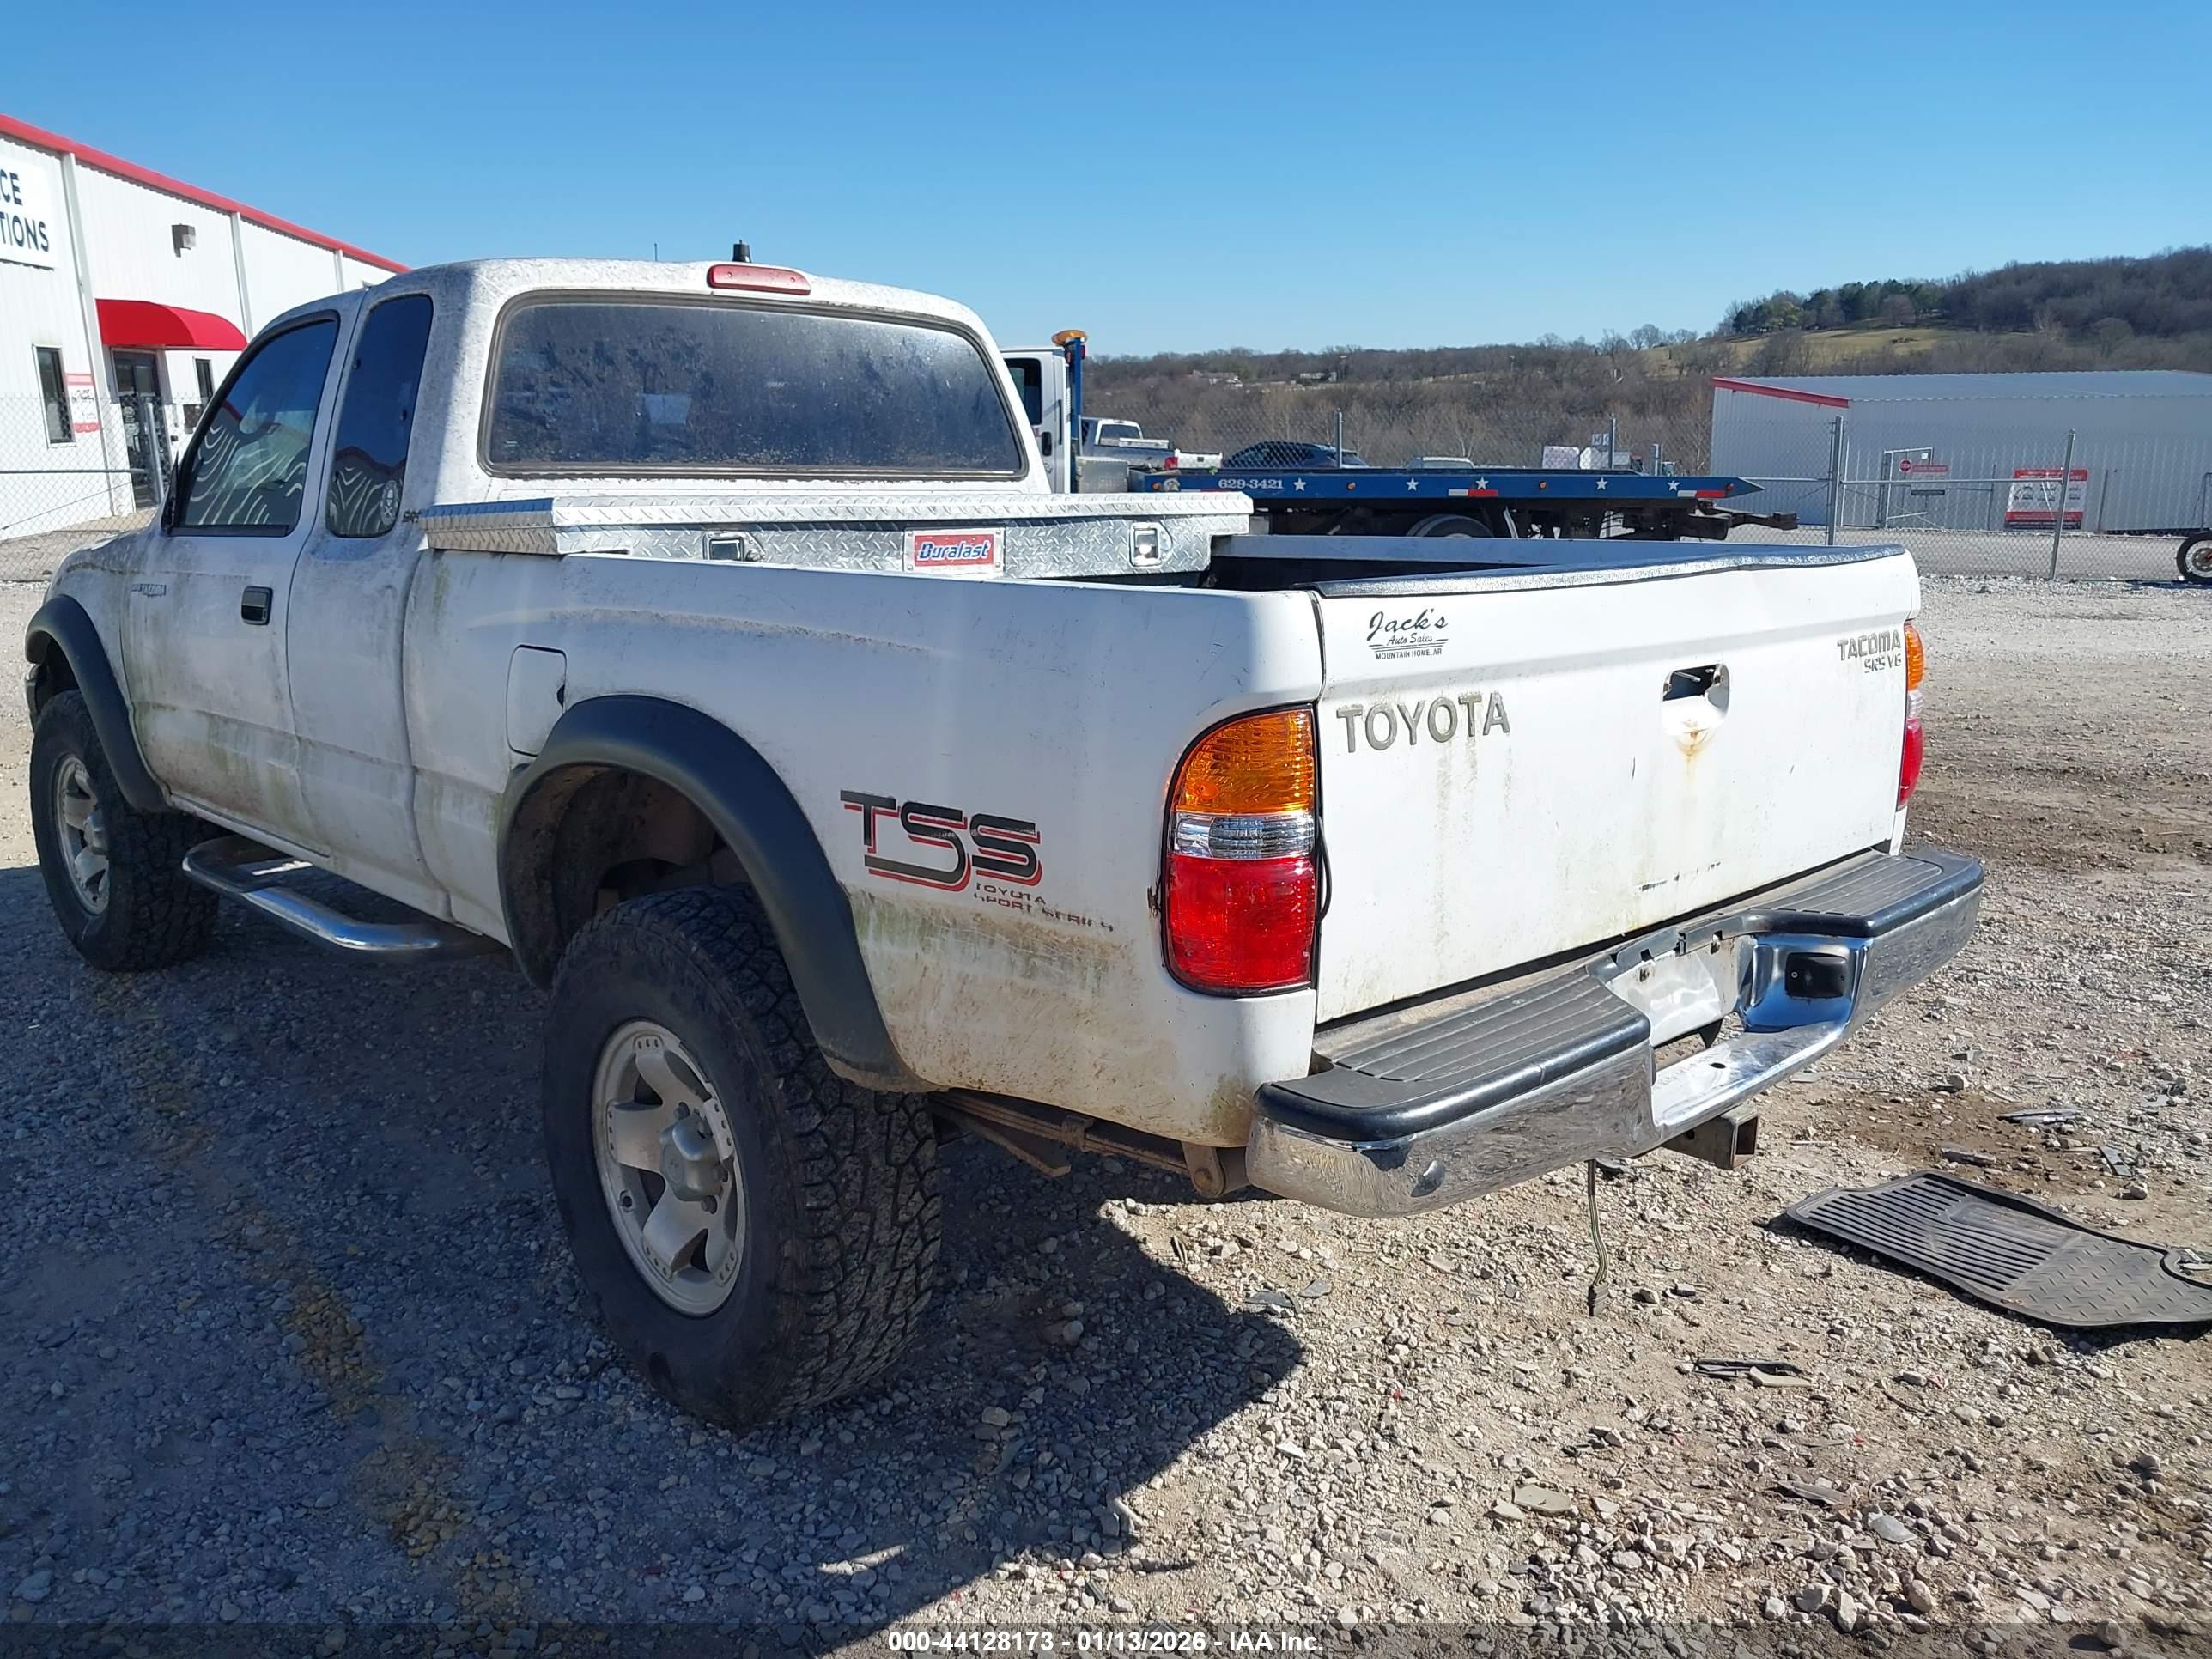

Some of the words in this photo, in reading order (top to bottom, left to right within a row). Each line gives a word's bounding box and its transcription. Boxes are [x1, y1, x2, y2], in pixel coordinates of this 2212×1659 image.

[1218, 478, 1284, 489] 629-3421
[918, 541, 991, 561] Duralast
[1367, 608, 1448, 641] Jack's
[1386, 634, 1408, 646] Auto
[1410, 632, 1432, 643] Sales
[1837, 629, 1901, 661] TACOMA
[1376, 651, 1410, 660] MOUNTAIN
[1887, 653, 1902, 668] V6
[1336, 692, 1510, 753] TOYOTA
[840, 790, 1043, 891] TSS
